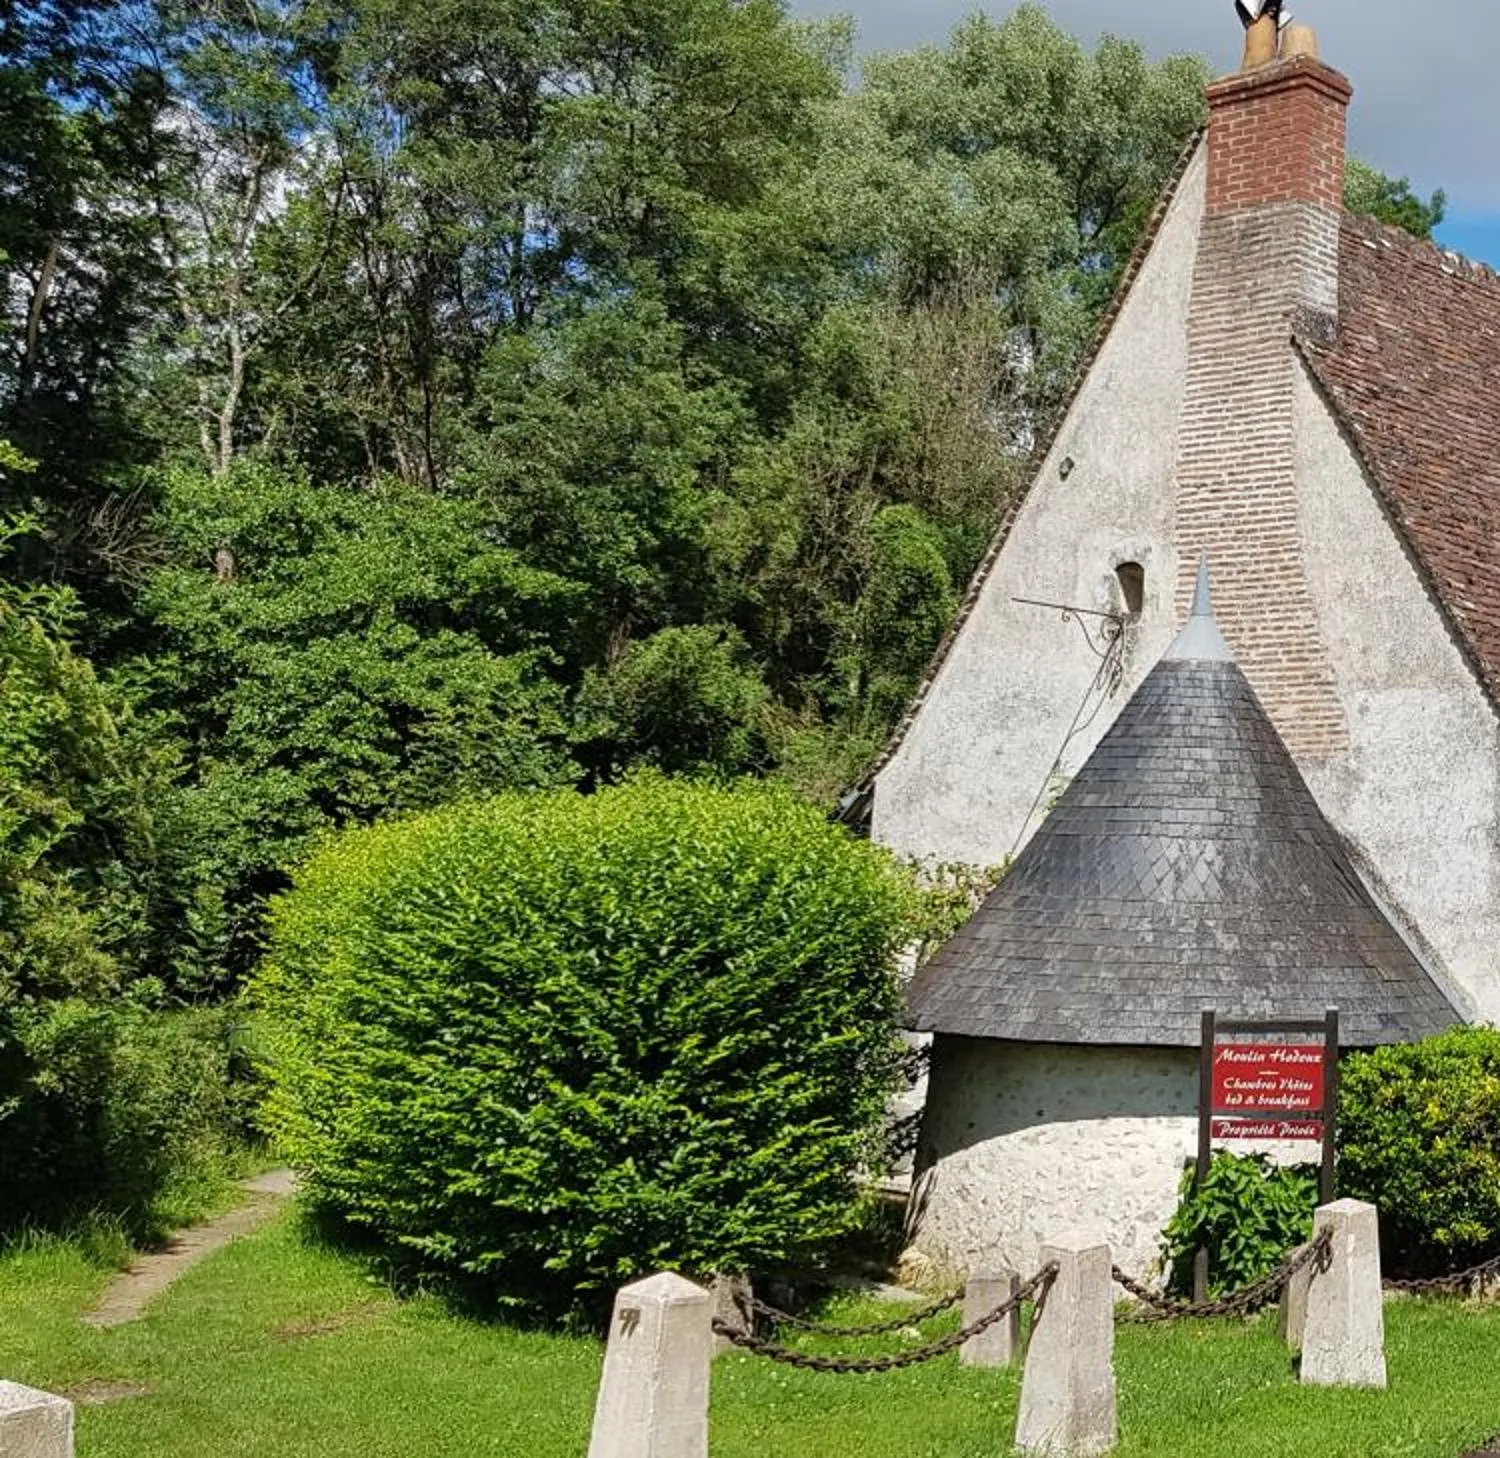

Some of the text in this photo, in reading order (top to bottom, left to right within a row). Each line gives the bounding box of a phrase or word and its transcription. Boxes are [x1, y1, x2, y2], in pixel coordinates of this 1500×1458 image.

[1215, 1048, 1265, 1064] Moulin
[1223, 1077, 1277, 1089] Chambres
[1225, 1093, 1311, 1109] bed & breakfast
